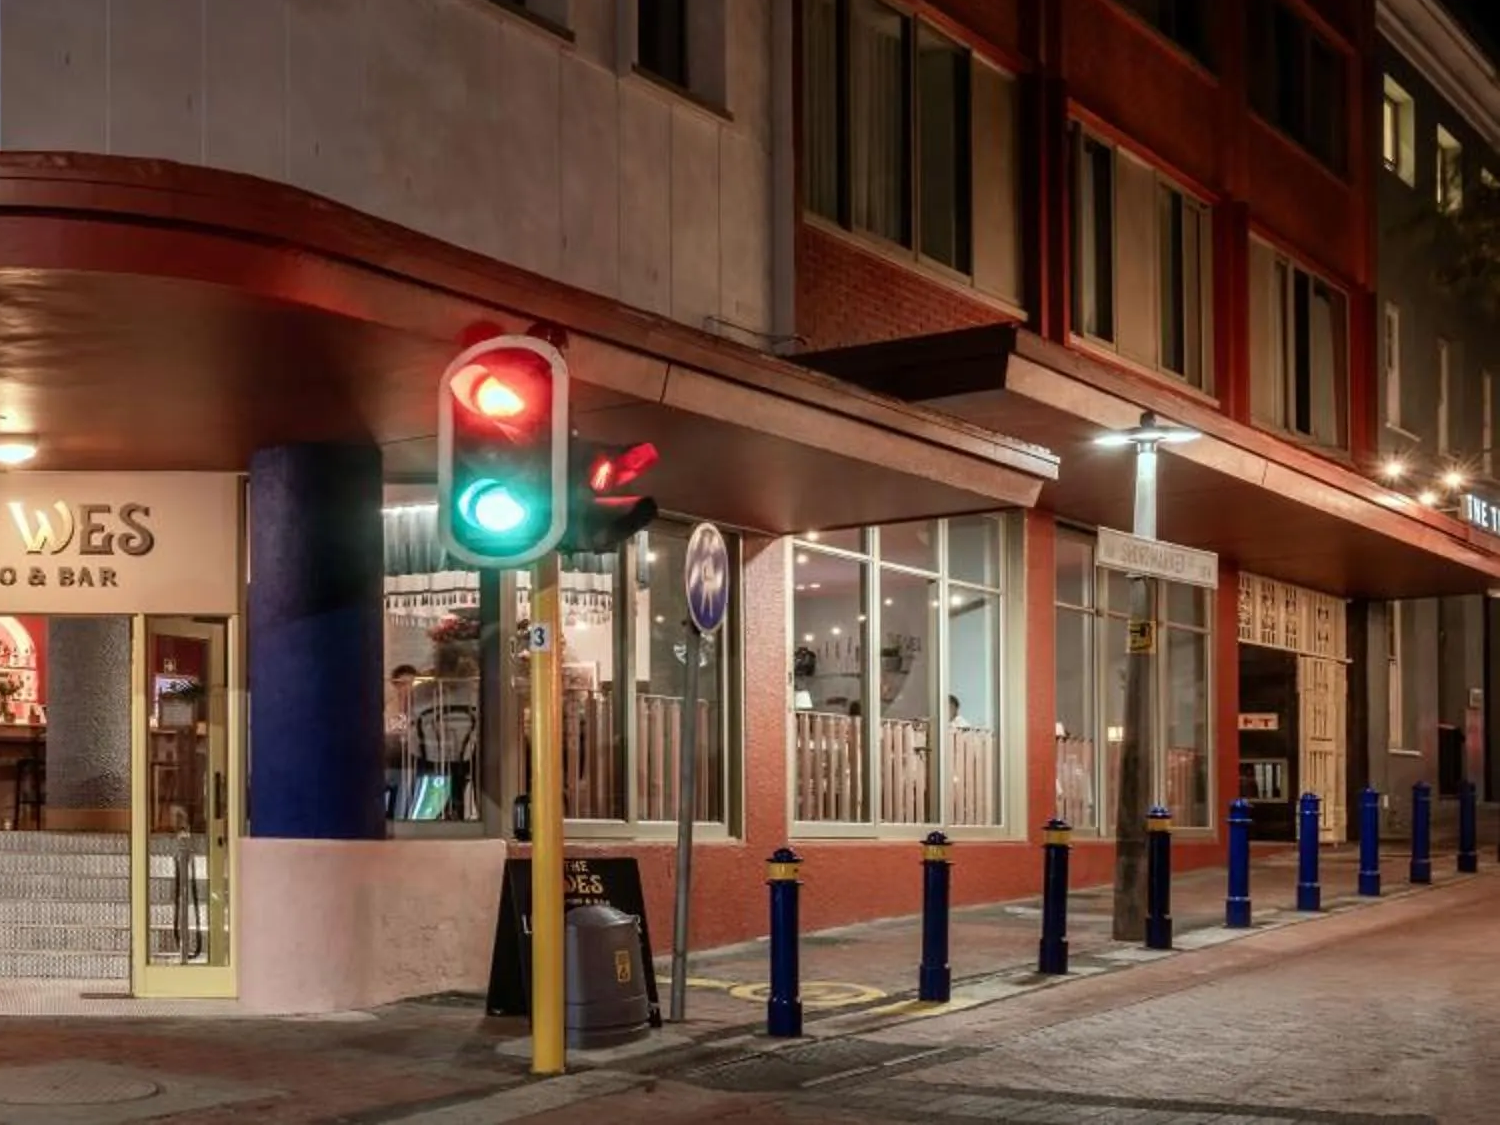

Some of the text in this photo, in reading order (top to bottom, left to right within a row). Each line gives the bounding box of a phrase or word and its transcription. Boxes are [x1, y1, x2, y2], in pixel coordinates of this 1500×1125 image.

[6, 499, 156, 556] WES
[27, 565, 48, 587] &
[58, 565, 118, 587] BAR
[534, 626, 545, 647] 3
